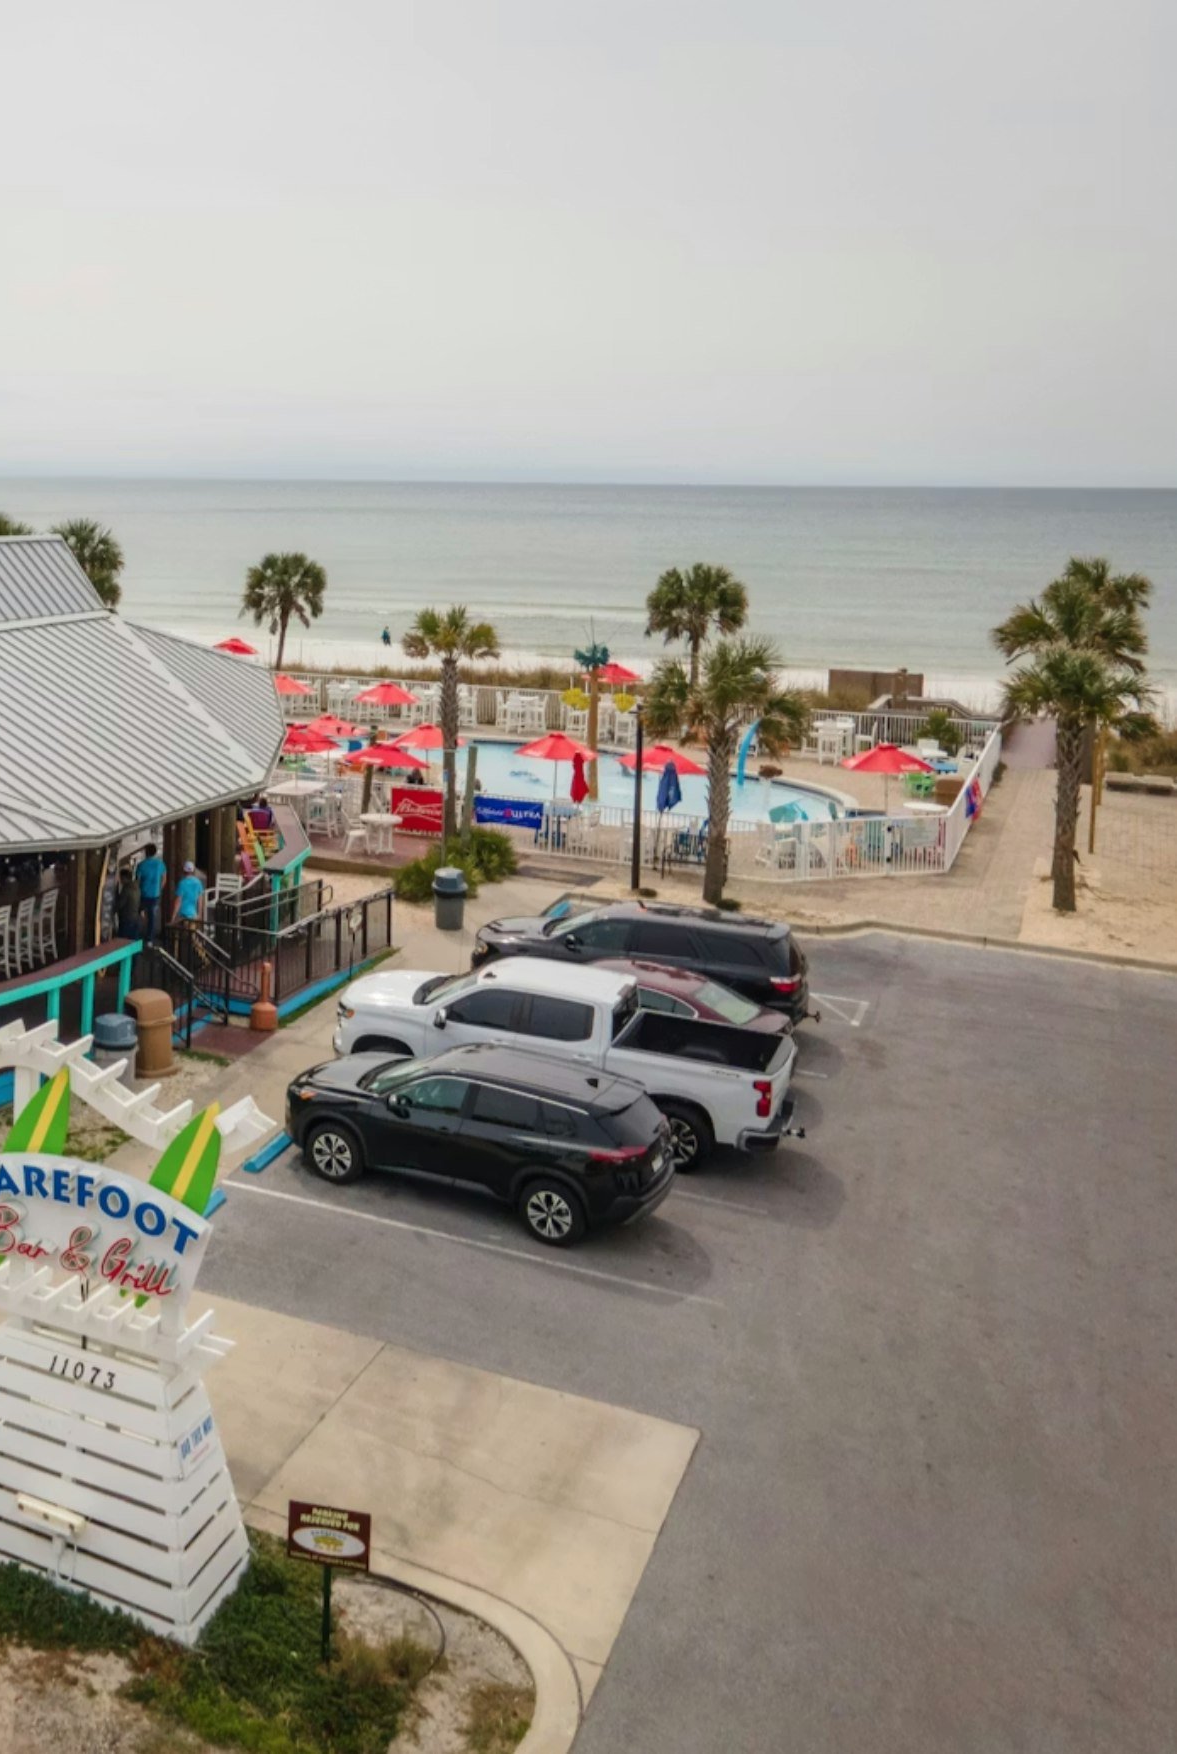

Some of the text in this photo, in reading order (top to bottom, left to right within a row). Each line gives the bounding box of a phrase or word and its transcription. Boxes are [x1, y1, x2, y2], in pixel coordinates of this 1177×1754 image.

[511, 809, 541, 819] ULTRA
[59, 1225, 94, 1271] &
[101, 1237, 173, 1297] Grill
[49, 1355, 115, 1390] 11073
